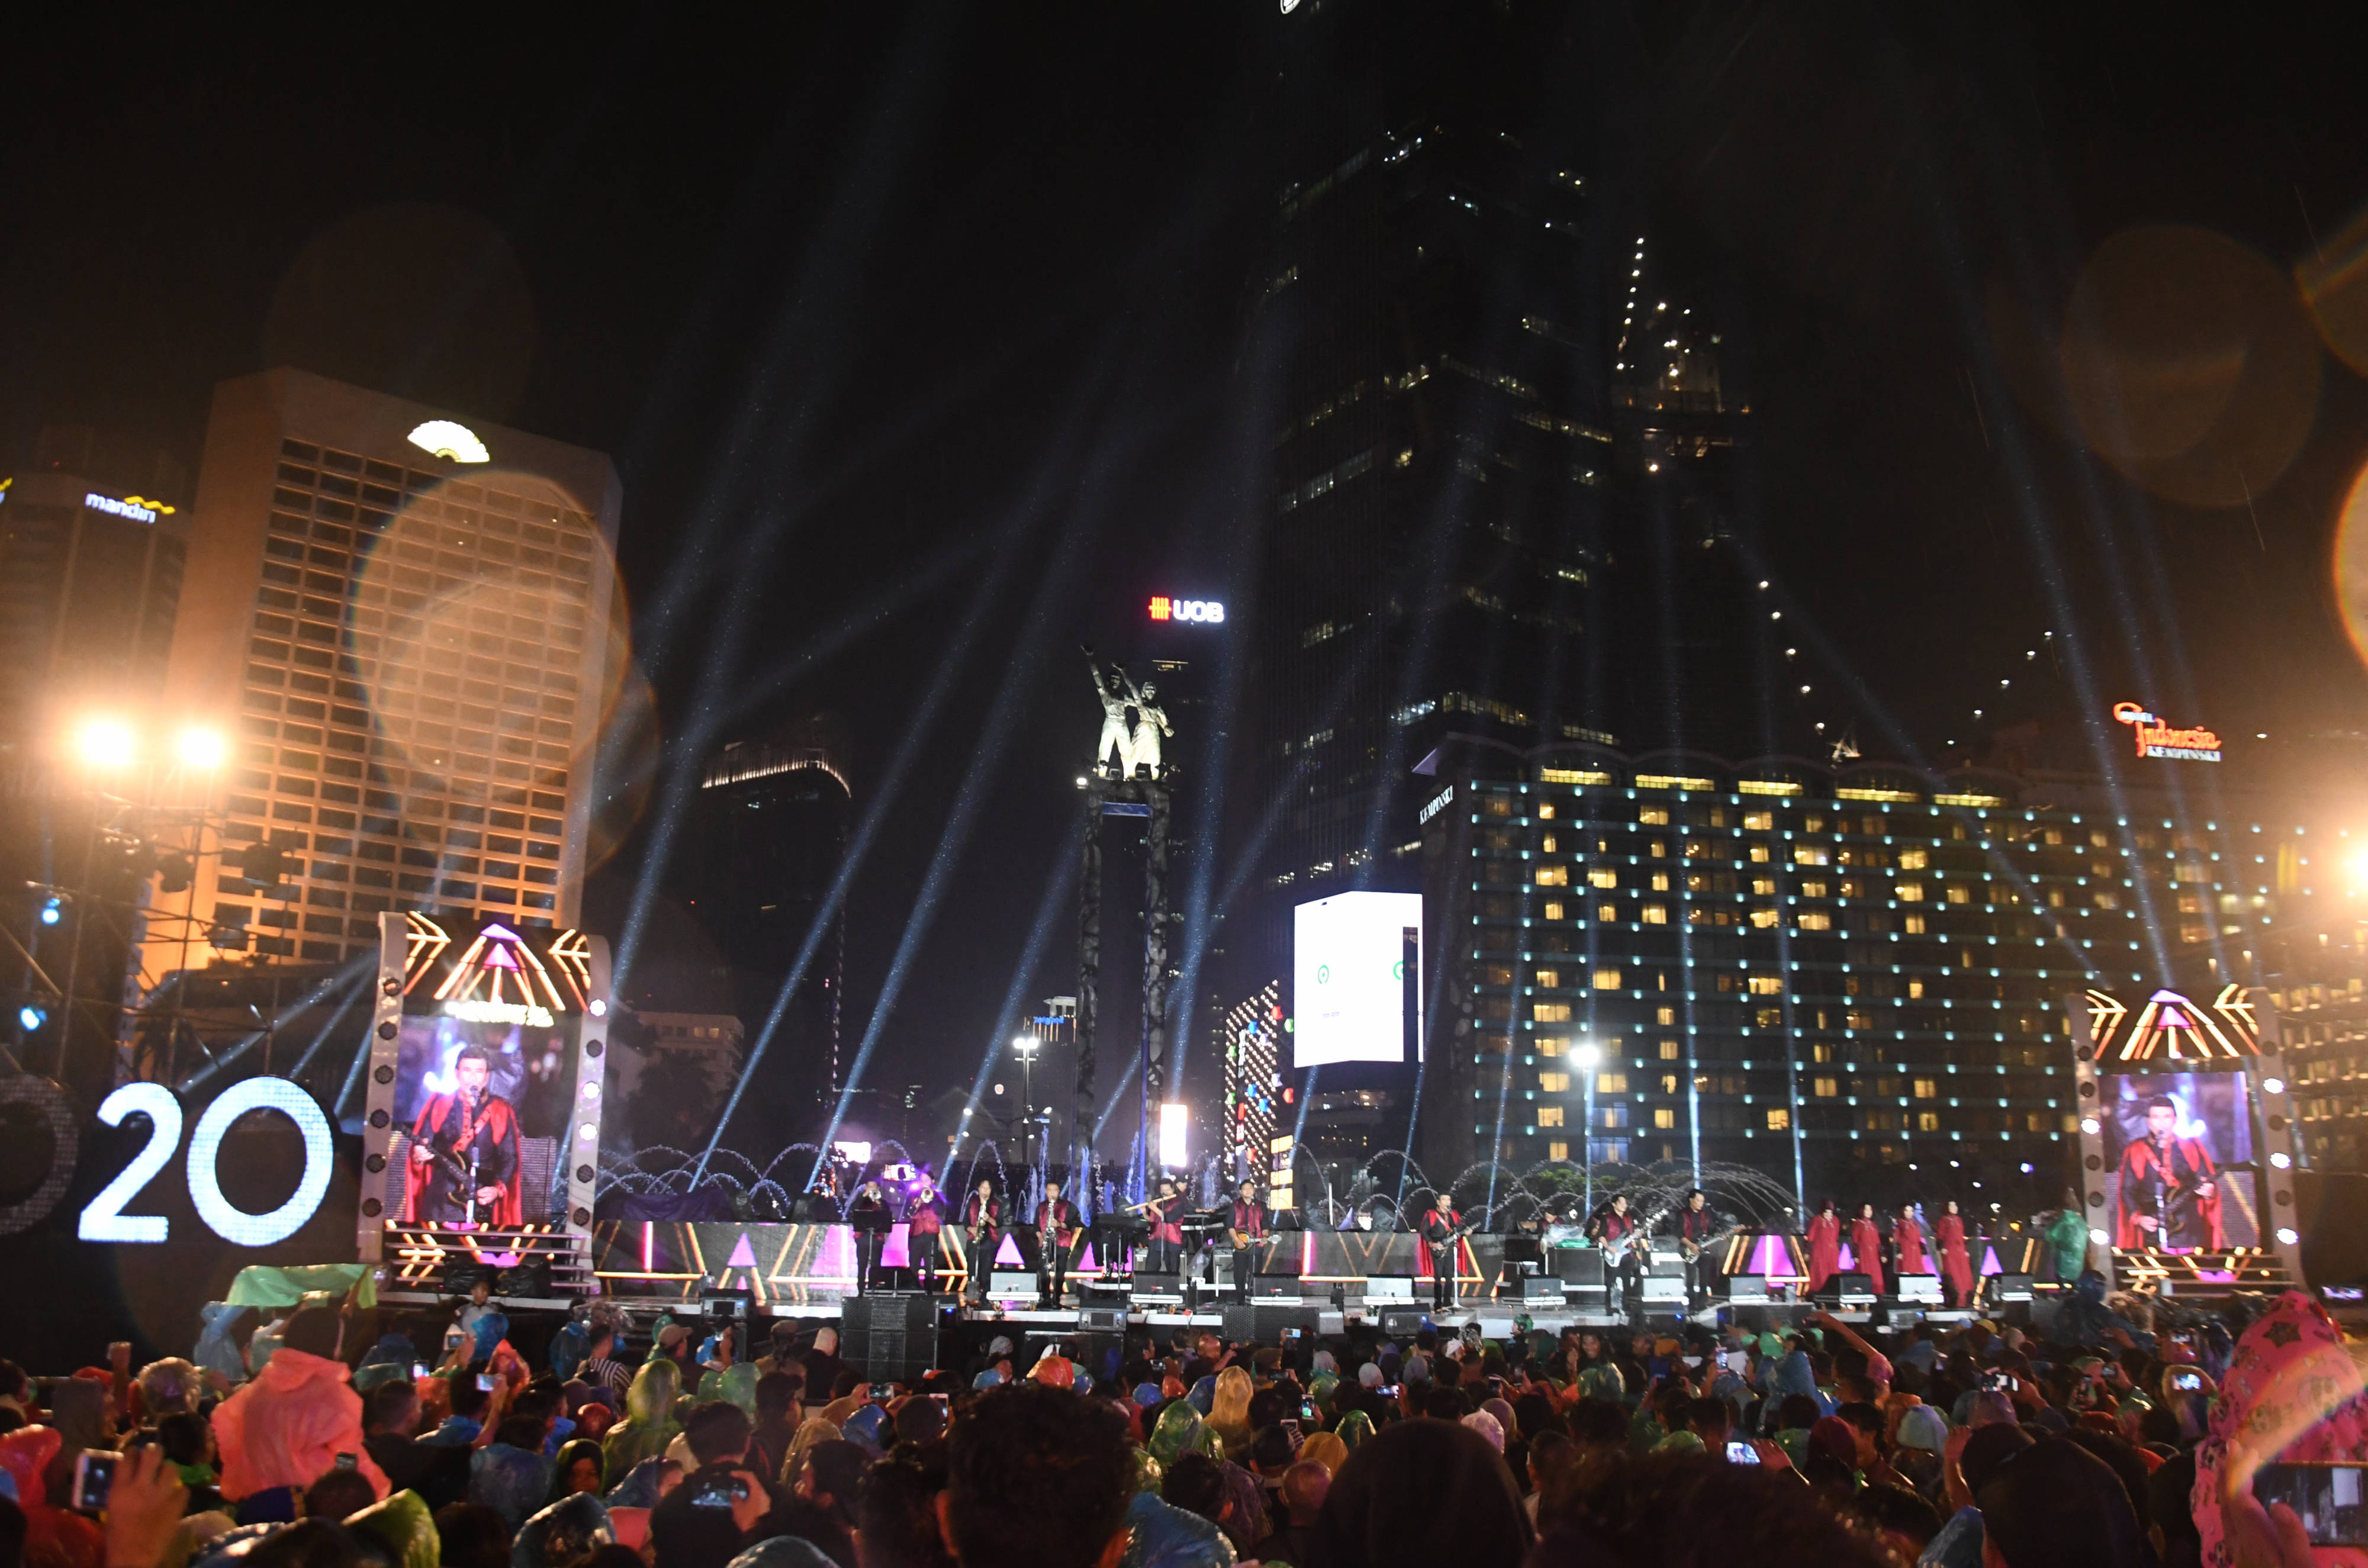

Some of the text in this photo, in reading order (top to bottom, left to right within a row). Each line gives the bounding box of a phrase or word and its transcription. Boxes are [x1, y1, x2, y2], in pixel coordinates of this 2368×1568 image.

[85, 492, 156, 523] mandiri
[1173, 599, 1225, 622] UOB
[2113, 702, 2222, 757] Indonesia
